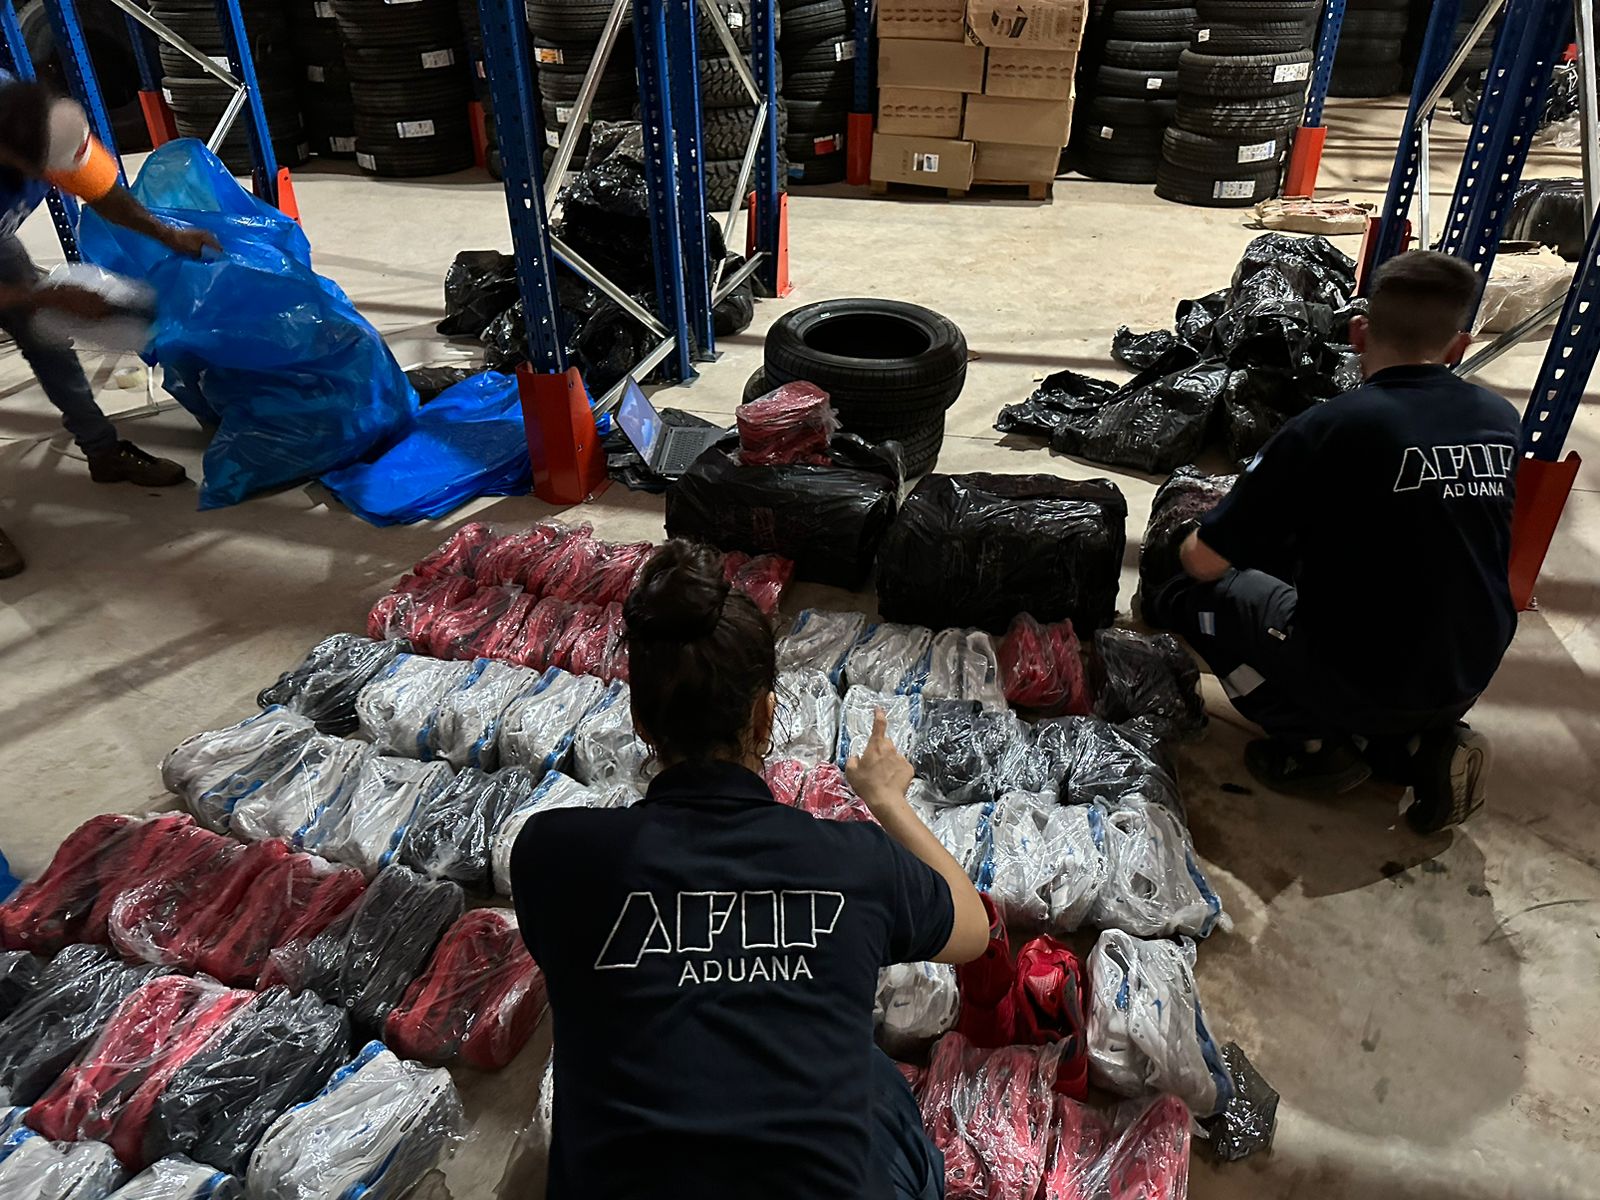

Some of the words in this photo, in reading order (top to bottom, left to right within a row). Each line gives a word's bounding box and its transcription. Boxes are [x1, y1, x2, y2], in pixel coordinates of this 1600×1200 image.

[1393, 444, 1514, 492] AFIP
[1443, 482, 1505, 499] ADUANA
[594, 890, 844, 970] AFIP
[678, 955, 813, 987] ADUANA
